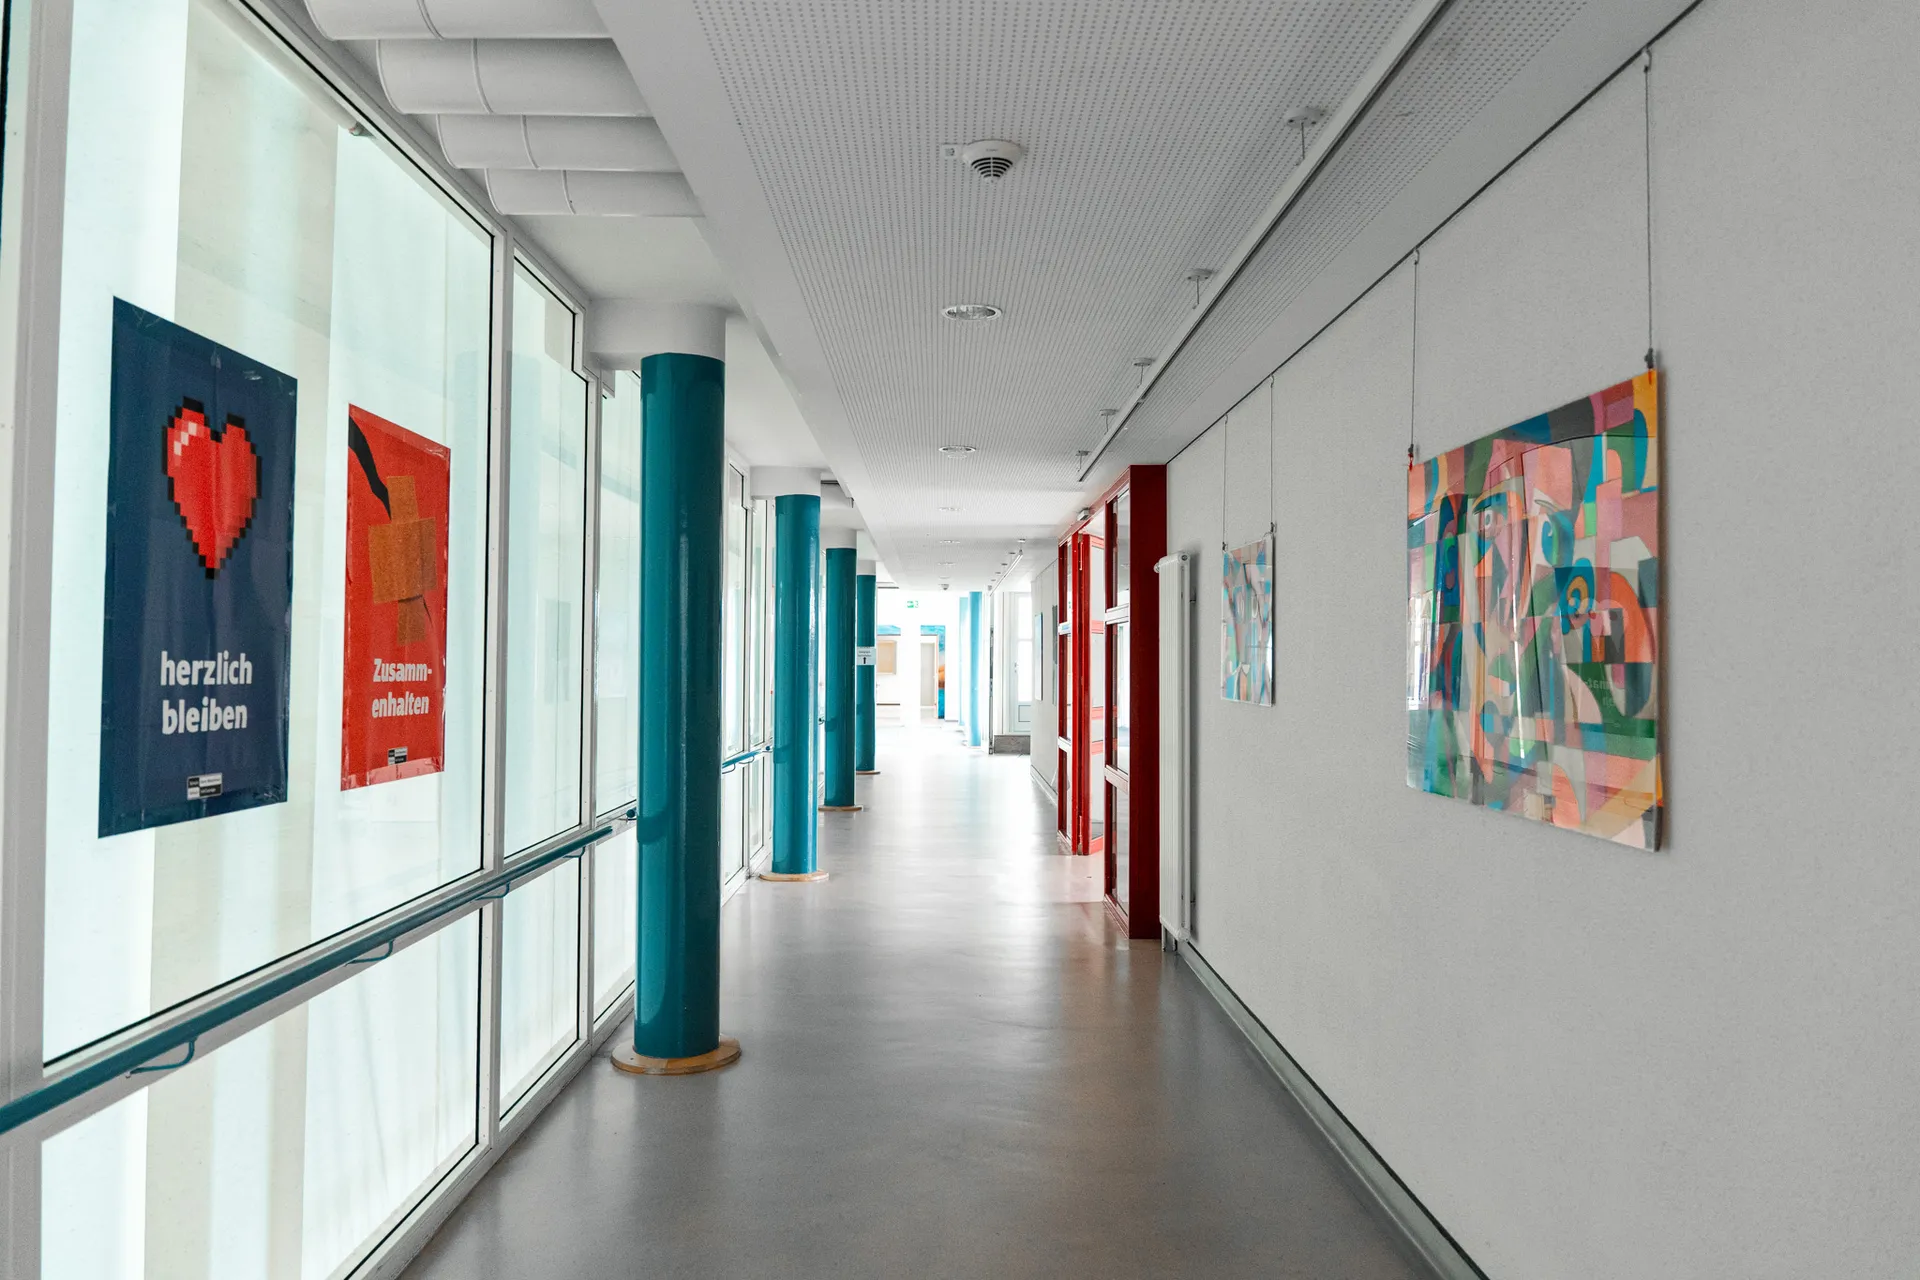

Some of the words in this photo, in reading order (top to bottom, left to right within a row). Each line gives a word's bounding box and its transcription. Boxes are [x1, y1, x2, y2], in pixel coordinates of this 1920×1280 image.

[160, 650, 253, 686] herzlich
[373, 658, 433, 682] Zusamm-
[162, 696, 247, 735] bleiben
[372, 691, 429, 718] enhalten
